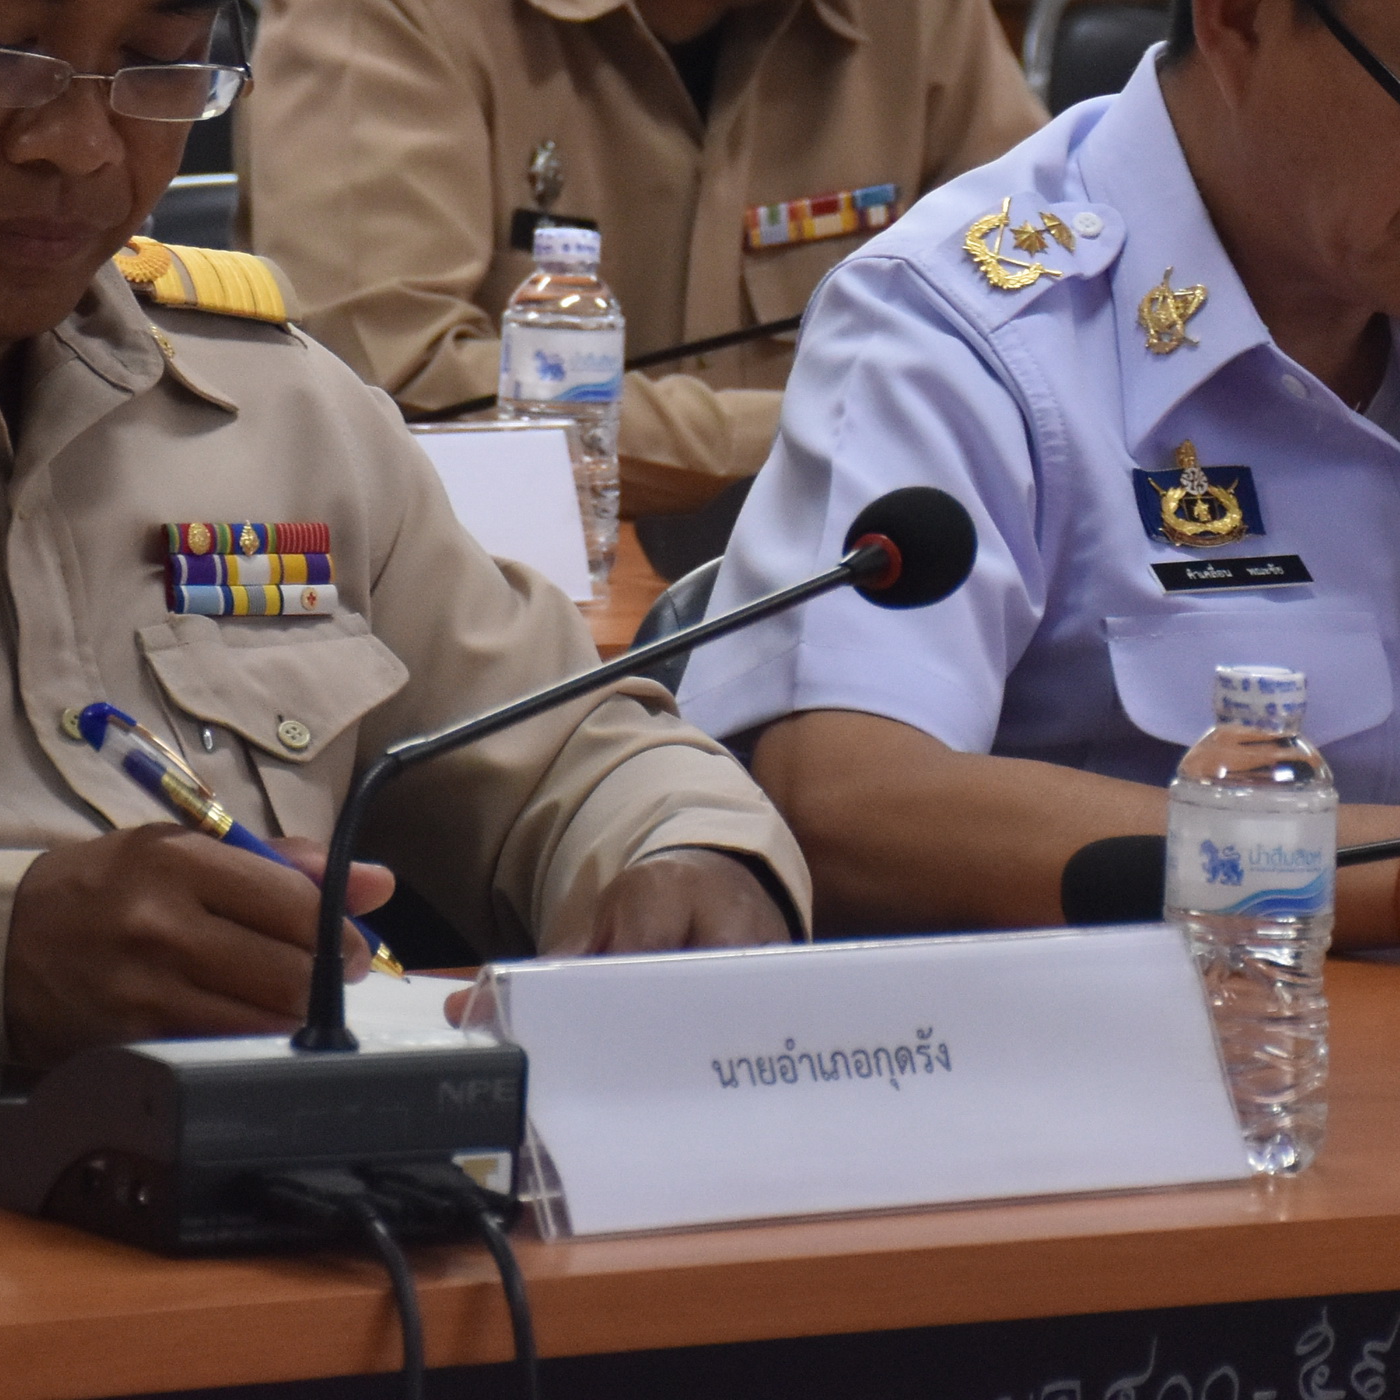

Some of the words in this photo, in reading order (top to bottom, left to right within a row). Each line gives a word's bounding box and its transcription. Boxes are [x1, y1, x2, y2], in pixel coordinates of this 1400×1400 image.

[712, 1026, 952, 1091] นายอำเภอกุดรัง
